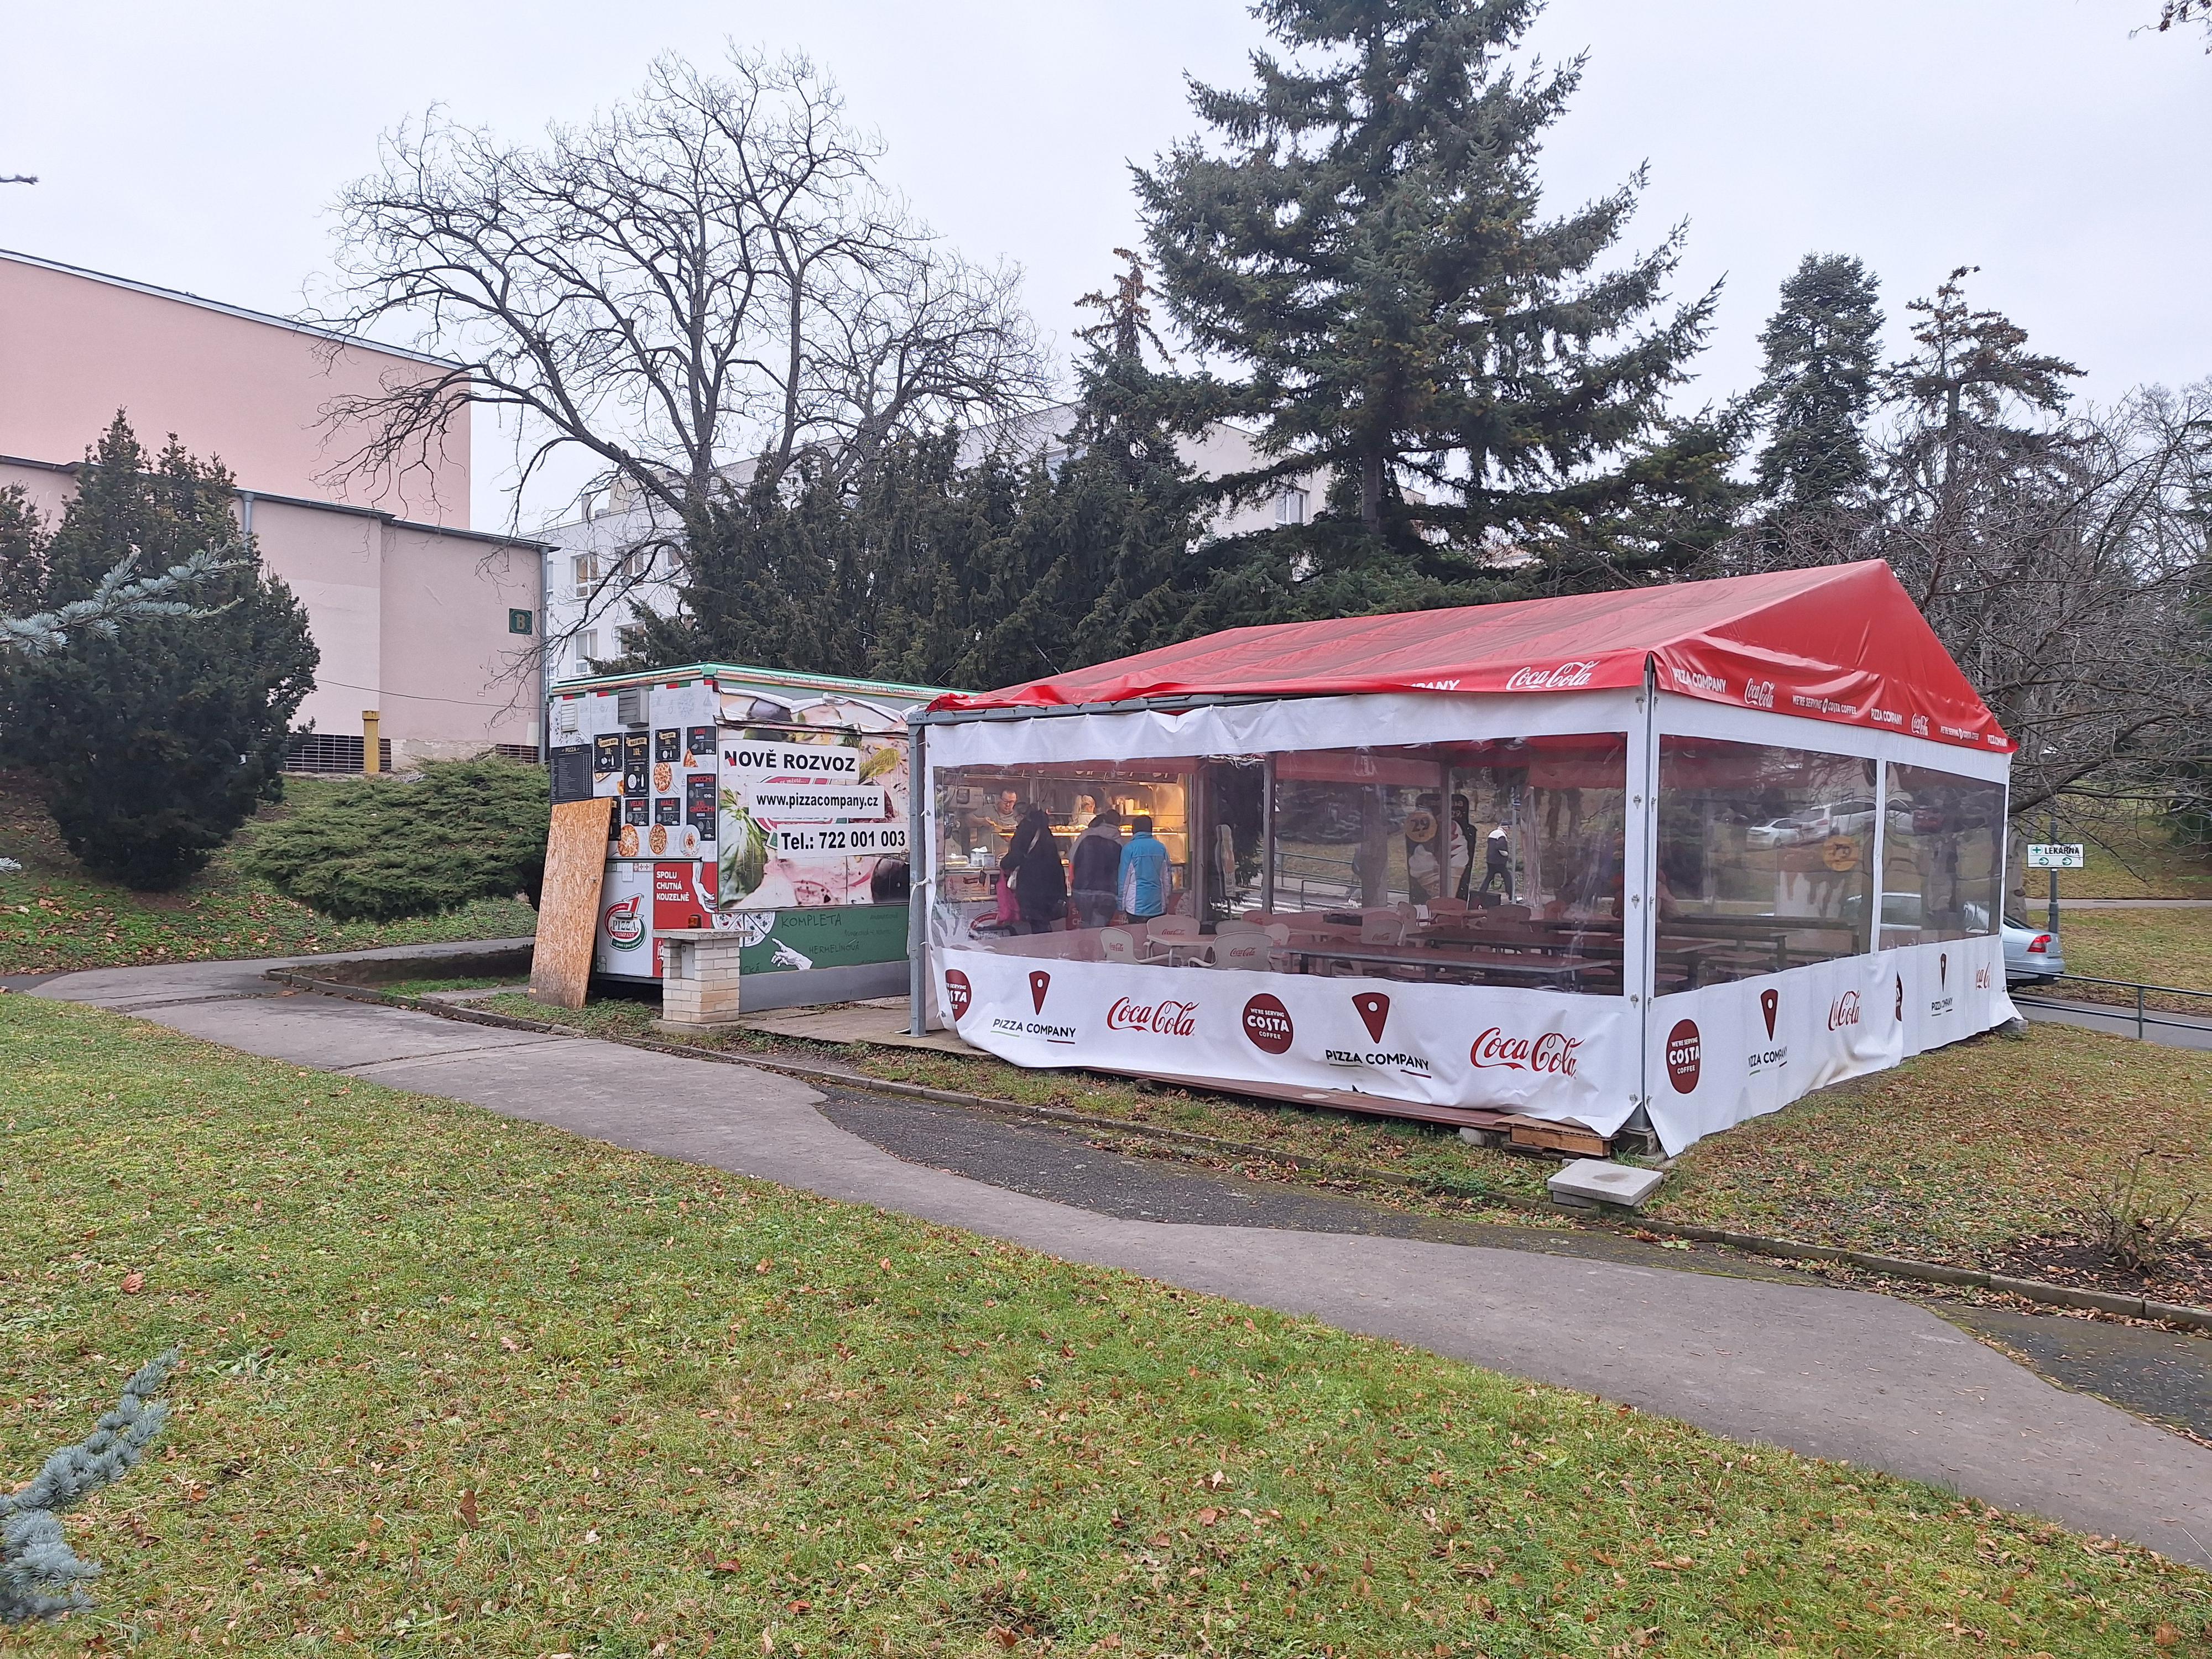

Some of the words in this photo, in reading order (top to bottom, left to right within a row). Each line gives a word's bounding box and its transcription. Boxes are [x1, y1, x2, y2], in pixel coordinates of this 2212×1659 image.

[516, 614, 526, 629] B
[1408, 679, 1460, 691] PANY
[1692, 672, 1726, 693] COMPANY
[1805, 697, 1822, 709] SERVING
[1828, 701, 1840, 713] COSTA
[1841, 703, 1858, 715] COFFEE
[724, 749, 776, 768] NOVĚ
[784, 754, 855, 772] ROZVOZ
[757, 792, 878, 810] www.pizzacompany.cz
[781, 832, 814, 850] Tel.:
[819, 832, 846, 849] 722
[851, 831, 875, 848] 001
[881, 831, 905, 847] 003
[656, 871, 677, 879] SPOLU
[656, 880, 682, 890] CHUTNÁ
[656, 891, 690, 901] KOUZELNĚ
[613, 920, 636, 931] PIZZA
[781, 914, 842, 928] KOMPLETA
[809, 941, 859, 954] HERMELÍNOVÁ
[949, 990, 967, 1003] STA
[1250, 1007, 1264, 1015] WE'RE
[1265, 1010, 1285, 1018] SERVING
[993, 1019, 1023, 1031] PIZZA
[1026, 1023, 1076, 1037] COMPANY
[1246, 1015, 1290, 1032] COSTA
[1259, 1031, 1282, 1040] COFFEE
[1684, 1036, 1698, 1045] SERVING
[1326, 1050, 1363, 1063] PIZZA
[1366, 1053, 1430, 1071] COMPANY
[1669, 1046, 1700, 1065] COSTA
[1677, 1065, 1695, 1074] COFFEE
